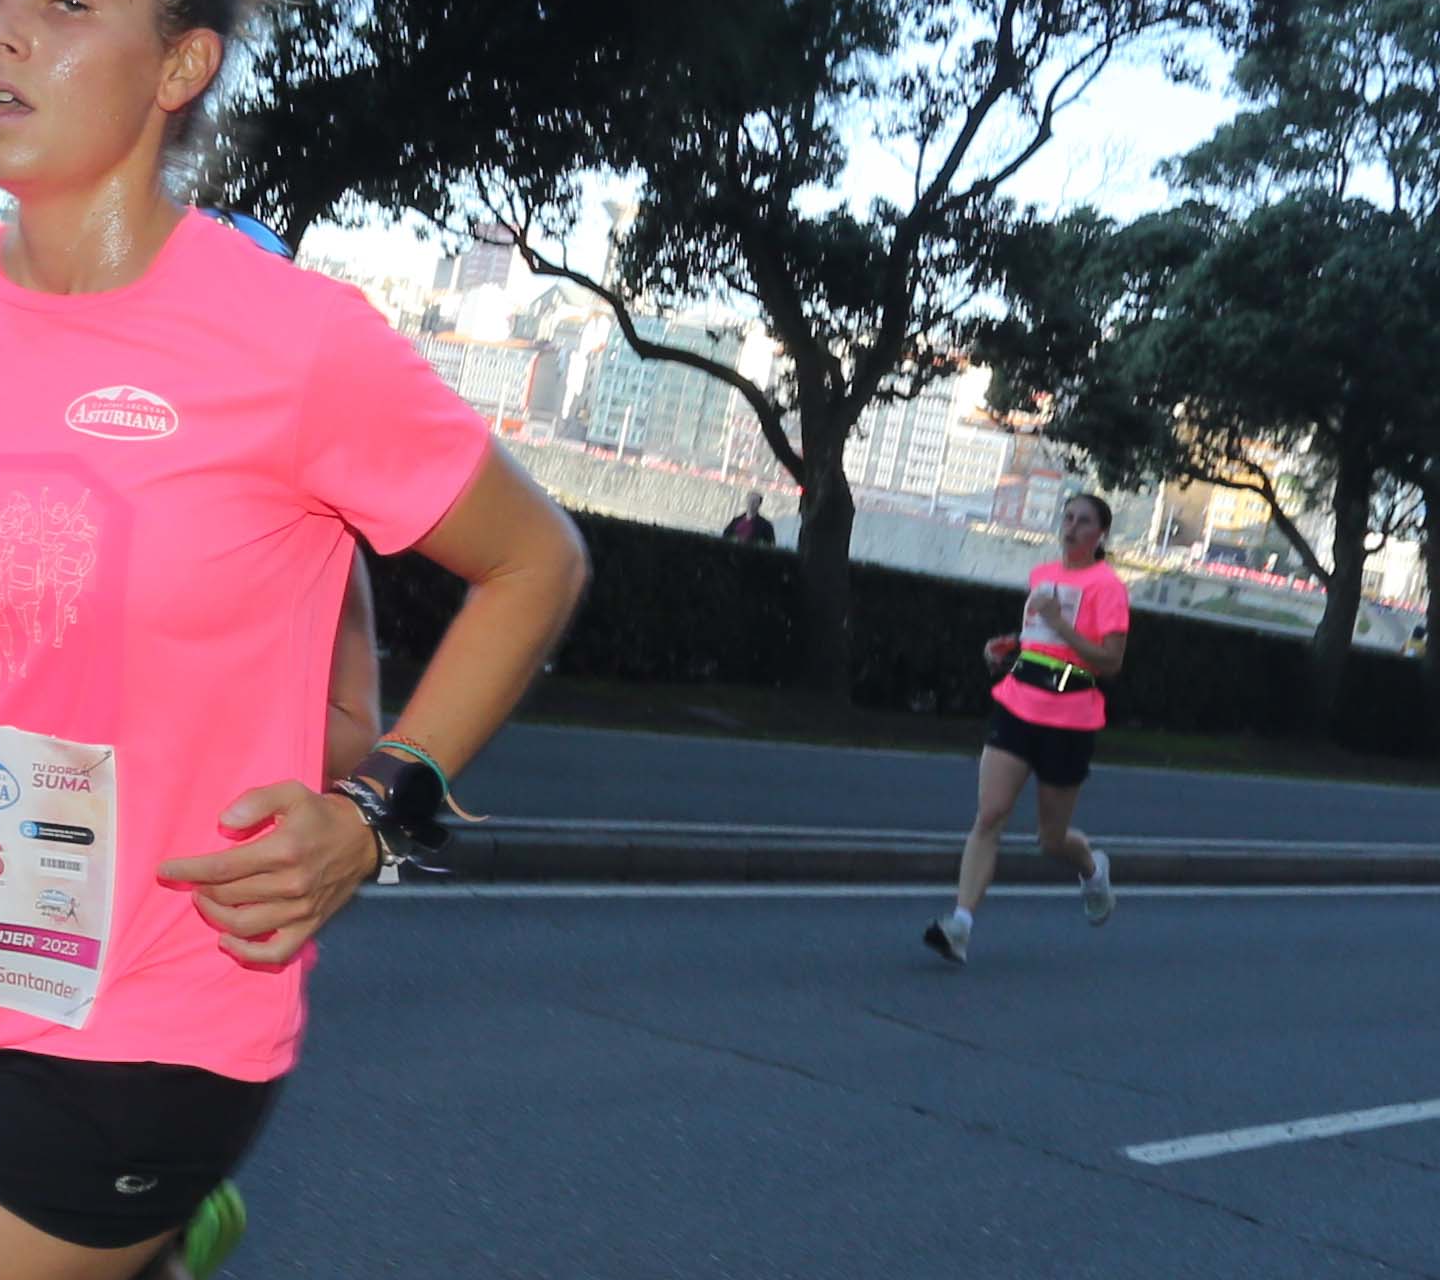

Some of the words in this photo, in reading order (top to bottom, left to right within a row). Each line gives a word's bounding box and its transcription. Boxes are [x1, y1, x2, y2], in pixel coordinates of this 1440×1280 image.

[71, 401, 169, 433] ASTURIANA
[32, 762, 46, 773] TU
[31, 773, 92, 793] SUMA
[41, 936, 80, 956] 2023
